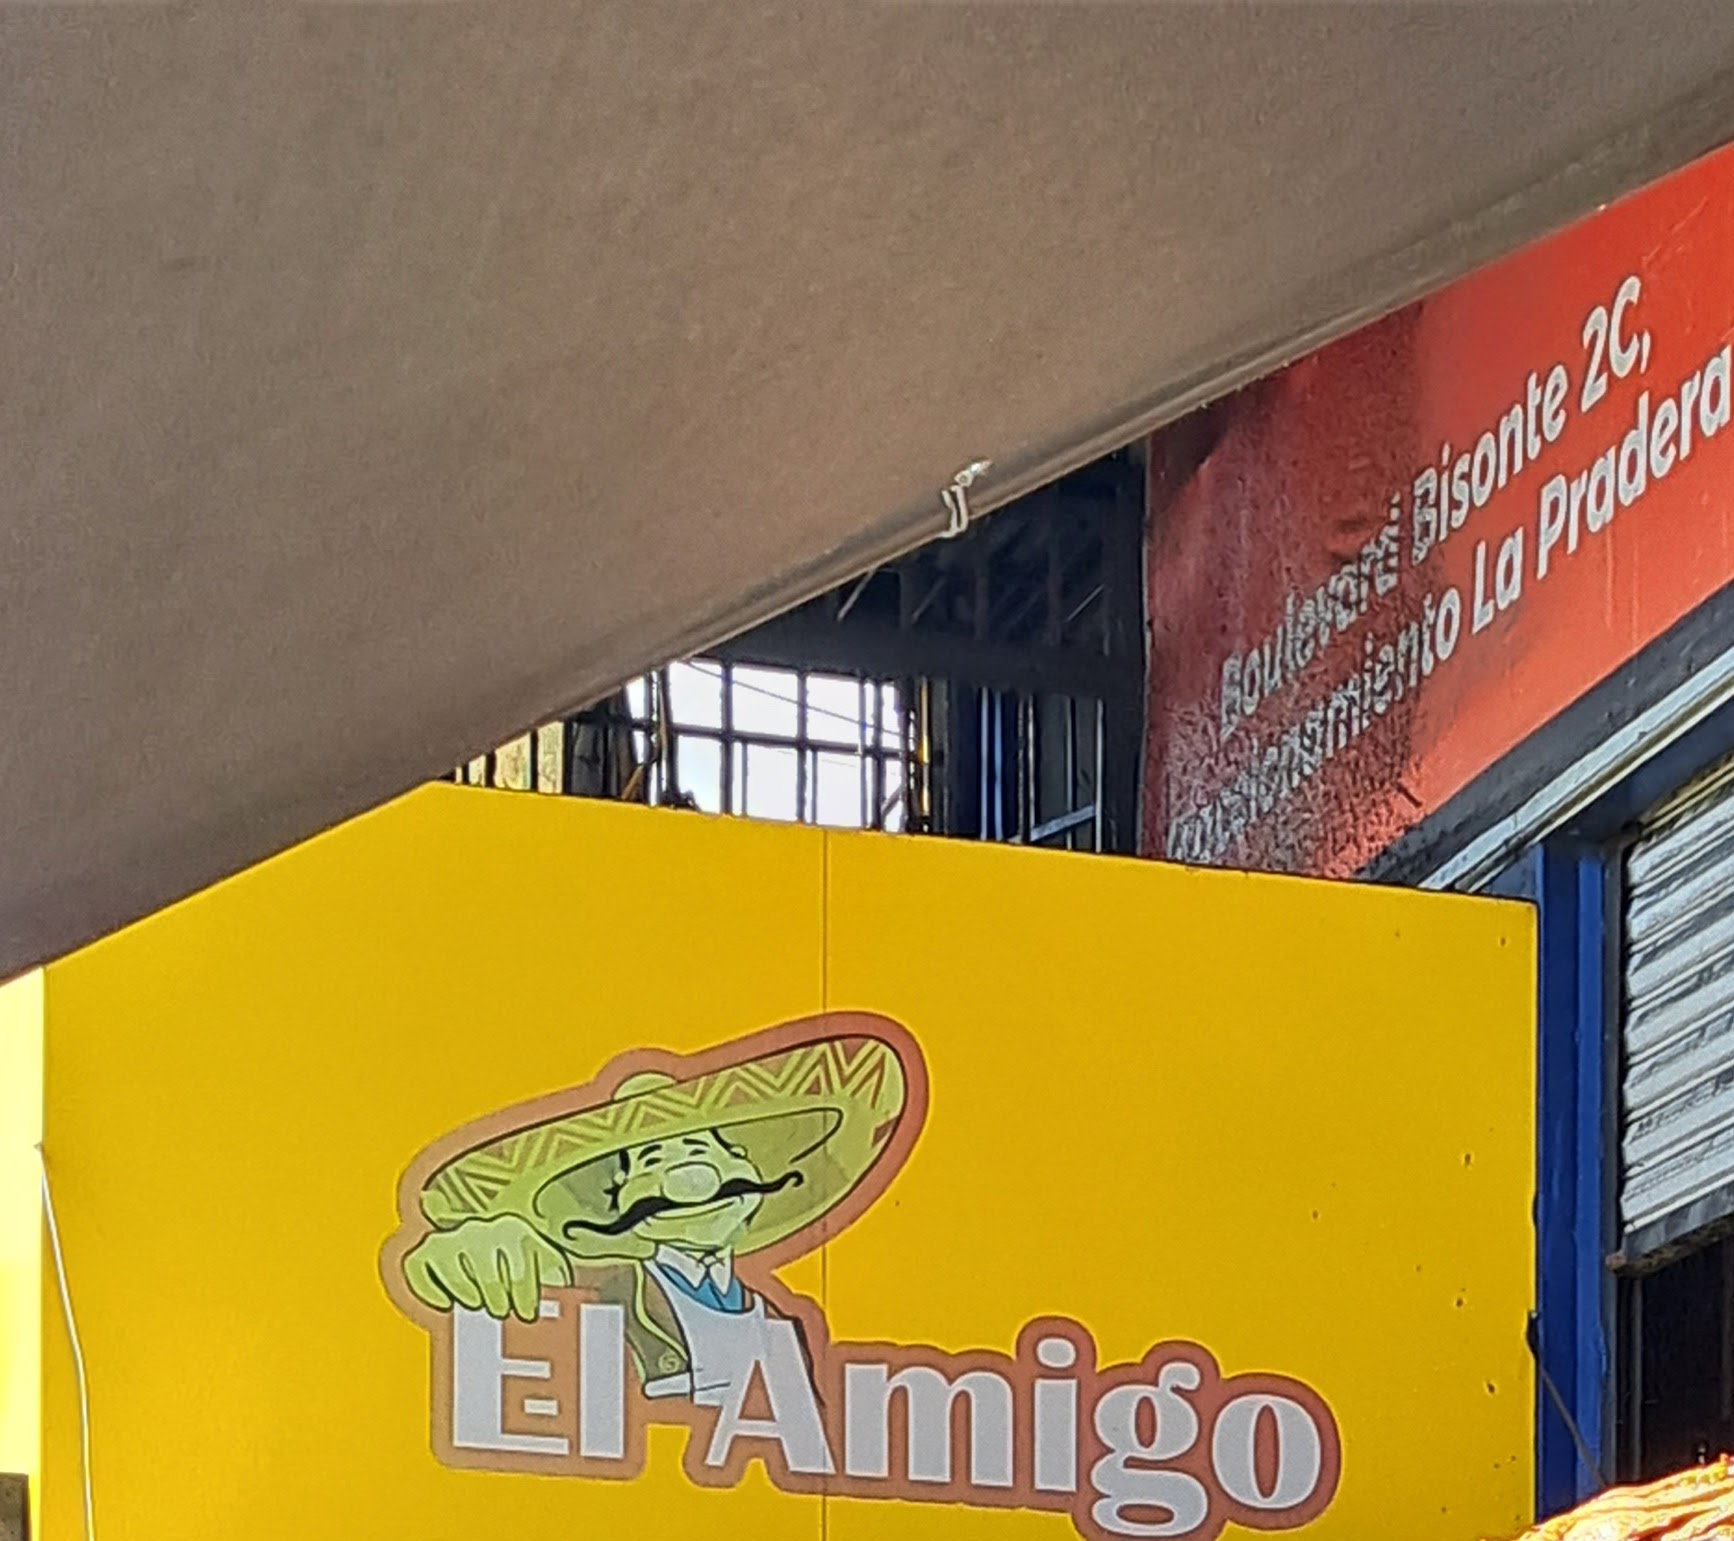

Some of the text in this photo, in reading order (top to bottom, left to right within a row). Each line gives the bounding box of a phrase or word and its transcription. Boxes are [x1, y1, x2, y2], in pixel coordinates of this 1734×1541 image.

[1412, 363, 1568, 567] Bisonte
[1581, 276, 1651, 413] 2C,
[1472, 527, 1524, 635] La
[1537, 344, 1733, 580] Pradera
[452, 1298, 1322, 1536] El Amigo
